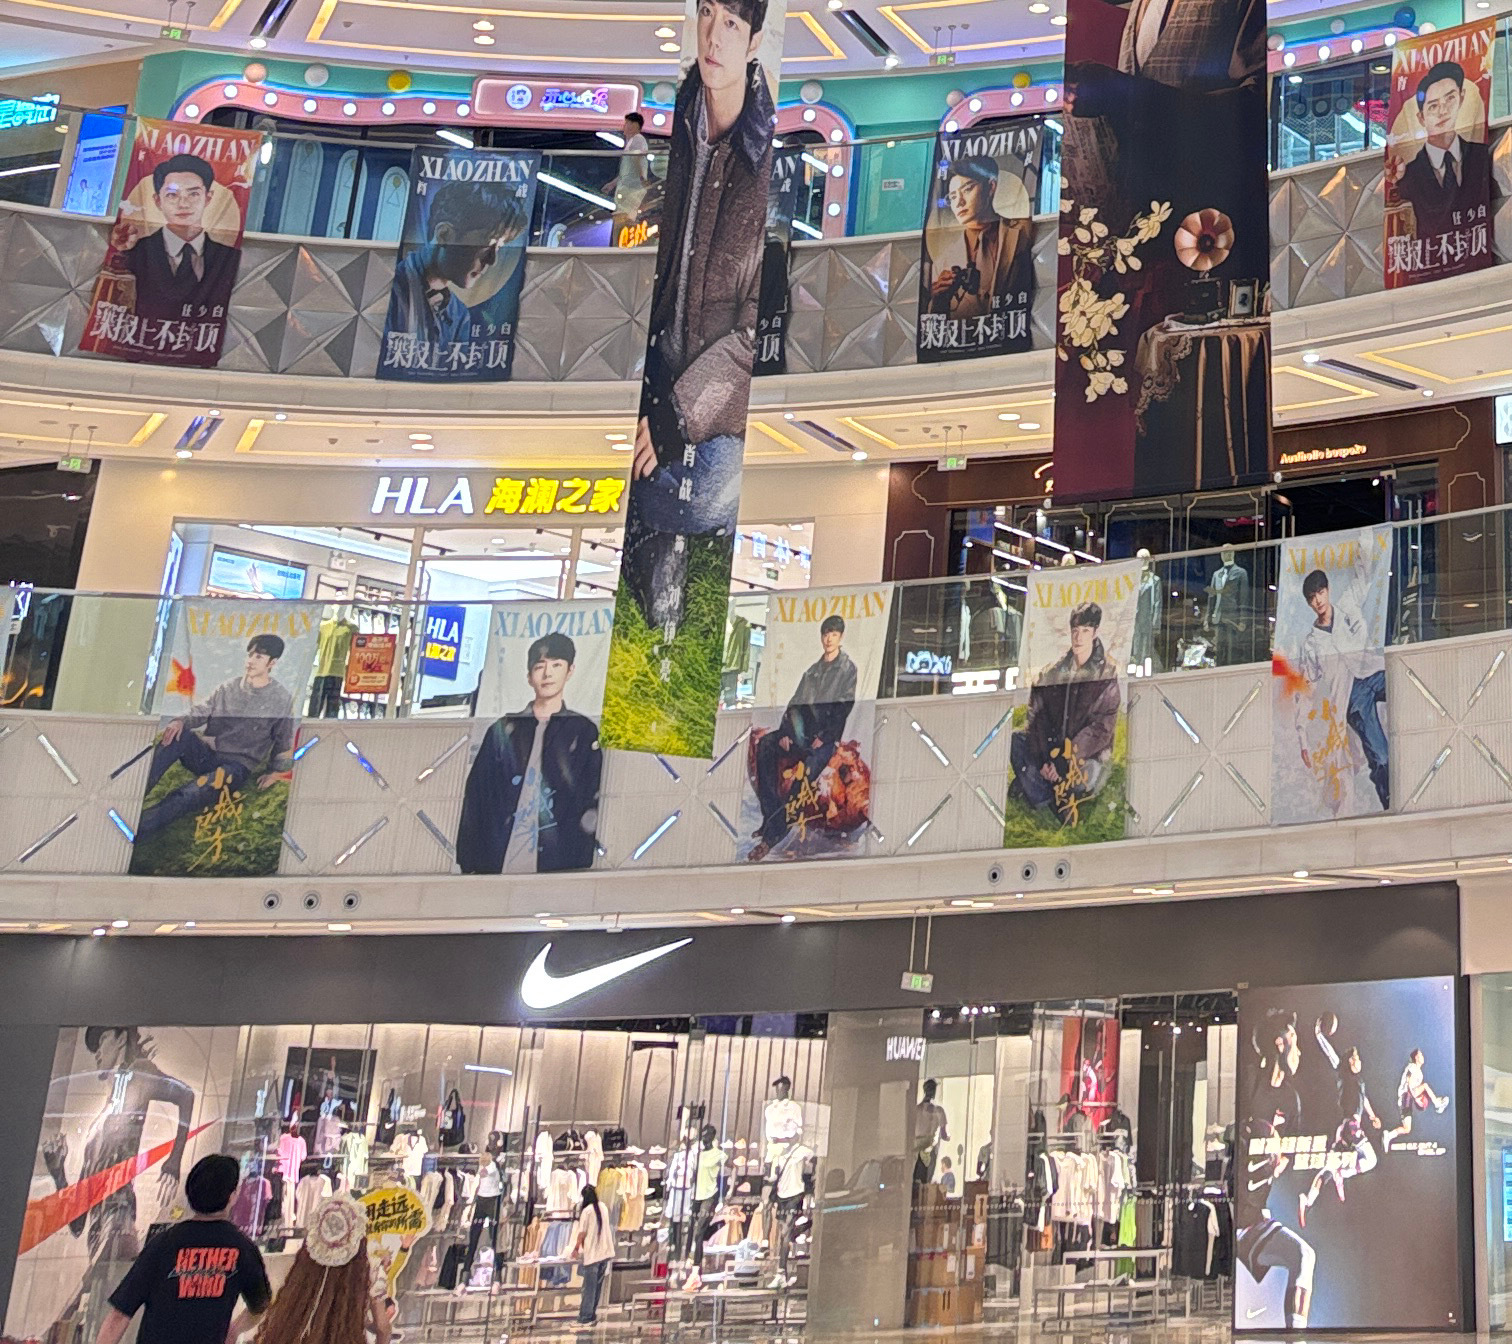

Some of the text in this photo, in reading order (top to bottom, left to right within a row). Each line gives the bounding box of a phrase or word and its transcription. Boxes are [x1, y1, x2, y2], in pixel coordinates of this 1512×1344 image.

[1394, 26, 1496, 76] XIAOZHAN
[137, 125, 259, 163] XIAOZHAN
[940, 125, 1042, 162] XIAOZHAN
[420, 155, 534, 183] XIAOZHAN
[371, 477, 474, 514] HLA
[484, 477, 626, 514] 海澜之家
[774, 589, 888, 624] XIAOZHAN
[1032, 570, 1136, 608] XIAOZHAN
[426, 616, 460, 643] HLA
[886, 1036, 926, 1062] HUAWEI
